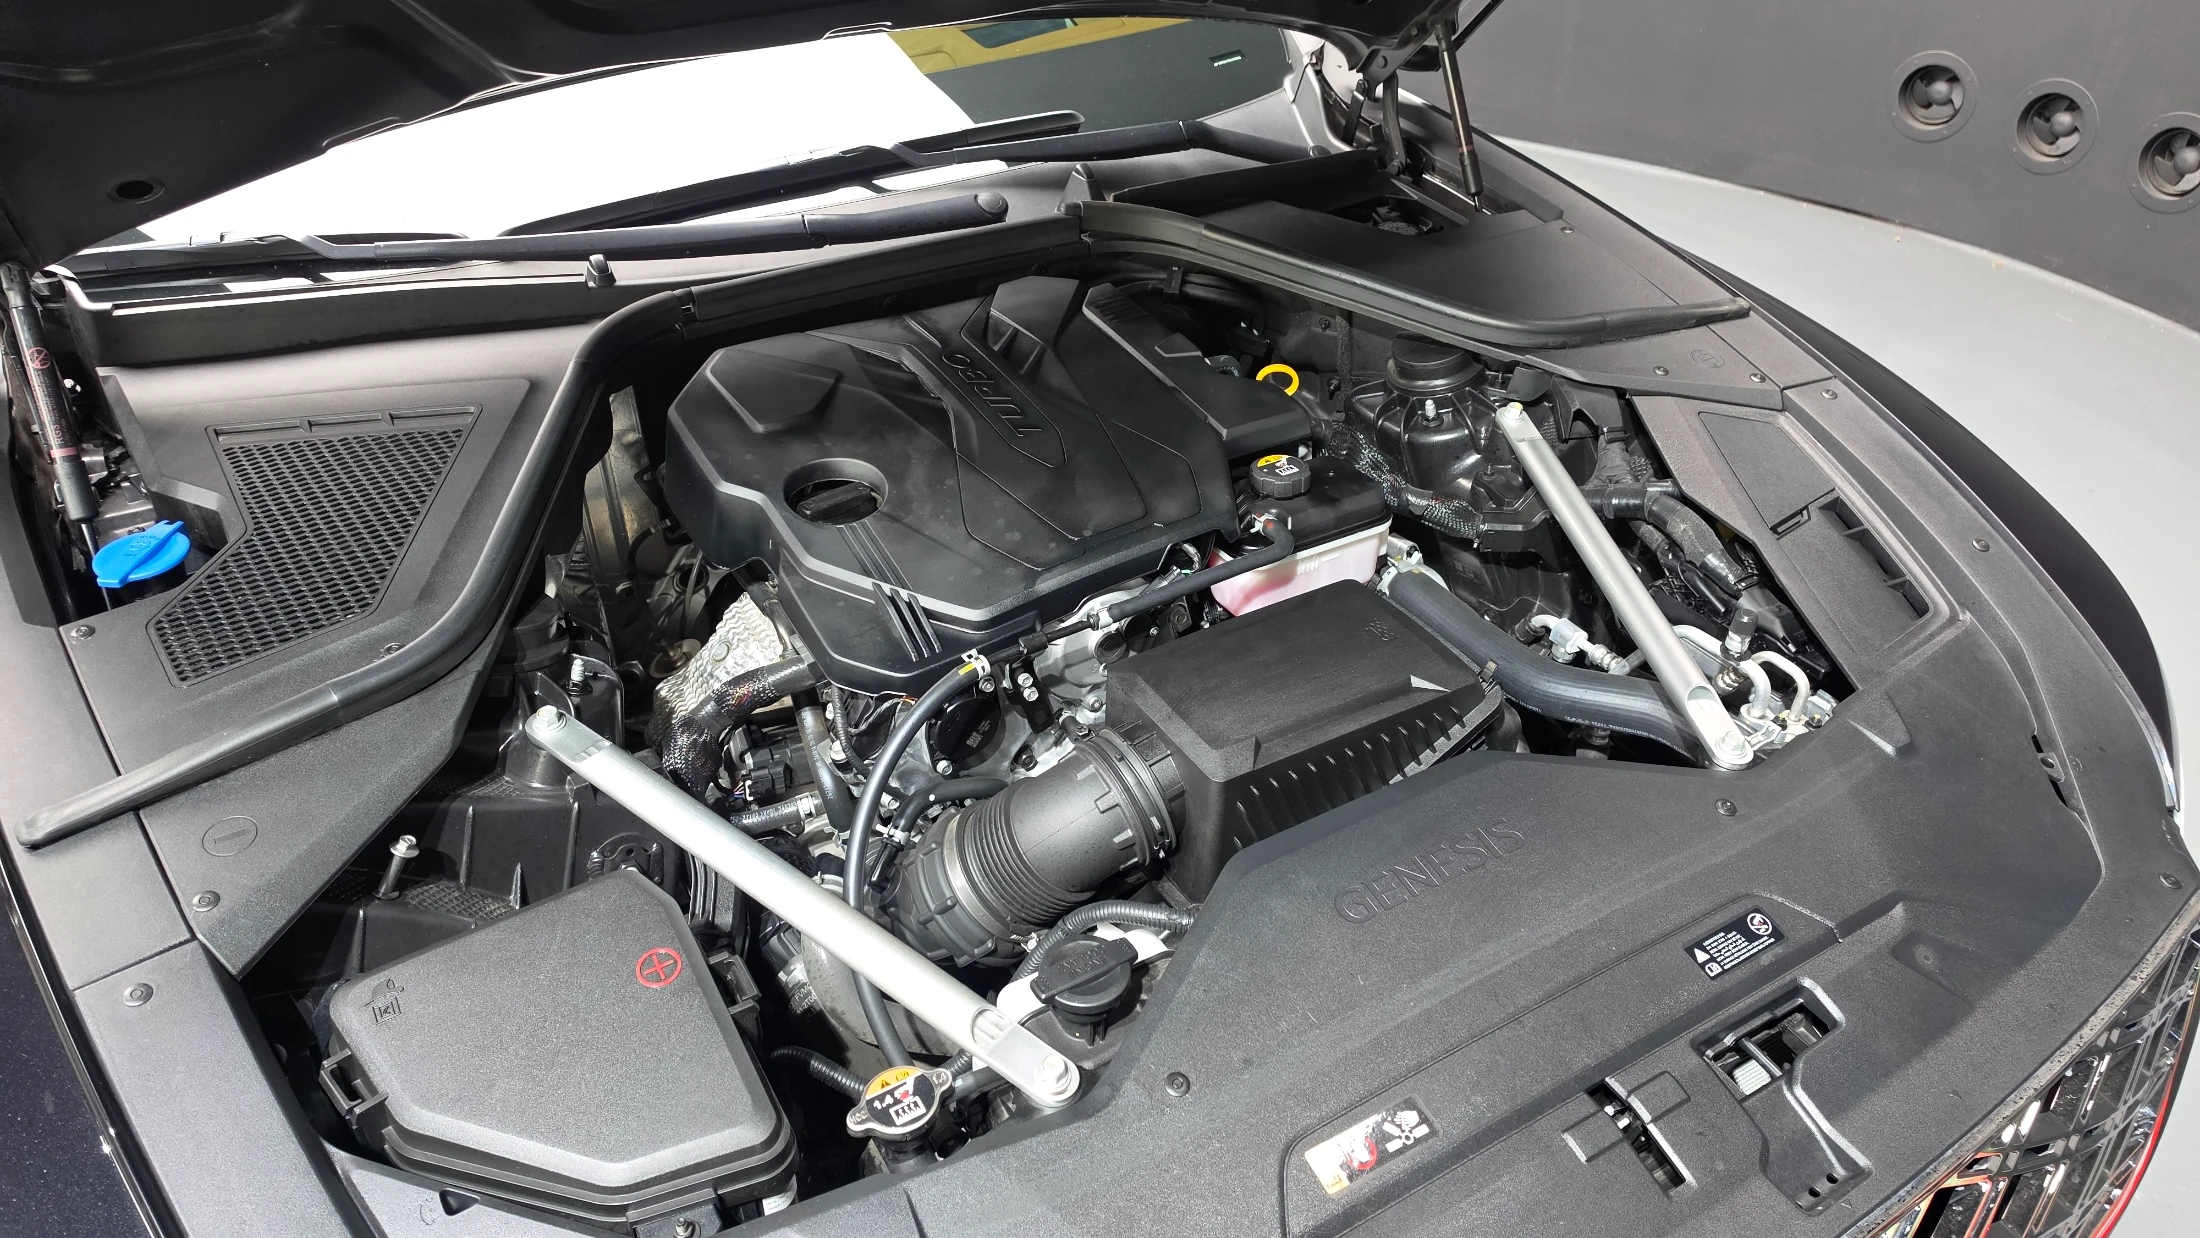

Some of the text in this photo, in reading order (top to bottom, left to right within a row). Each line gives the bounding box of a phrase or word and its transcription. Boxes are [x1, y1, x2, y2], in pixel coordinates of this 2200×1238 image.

[941, 353, 1042, 437] TURBO
[52, 425, 65, 444] RG3
[1333, 817, 1525, 924] GENESIS
[933, 1071, 947, 1085] 1.4
[873, 1094, 894, 1110] 1.4
